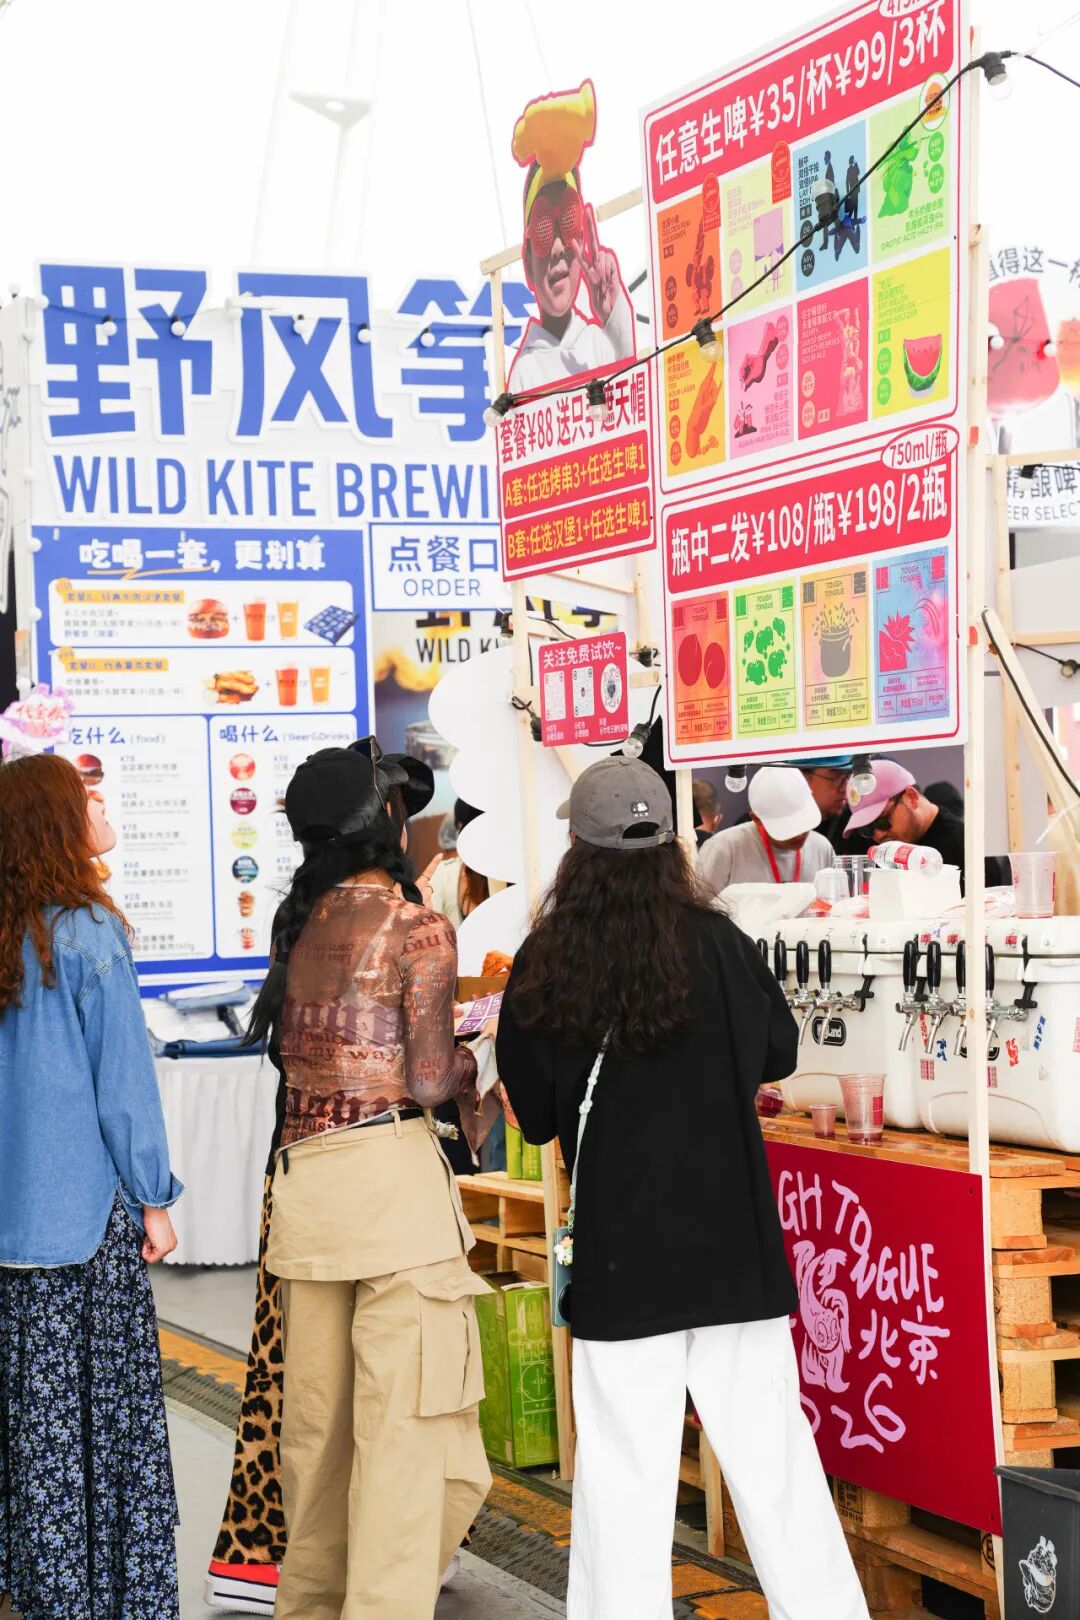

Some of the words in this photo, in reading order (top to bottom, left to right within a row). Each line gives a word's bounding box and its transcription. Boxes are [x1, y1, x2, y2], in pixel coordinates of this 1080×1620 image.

[40, 264, 537, 444] 野风筝
[890, 429, 948, 467] 750ml/瓶
[53, 456, 187, 515] WILD
[208, 459, 317, 517] KITE
[336, 462, 500, 519] BREWI
[672, 464, 949, 576] 瓶中二发¥108/瓶¥198/2瓶
[388, 536, 498, 574] 点餐口
[403, 578, 481, 597] ORDER
[416, 638, 470, 664] WILD
[219, 725, 278, 743] 喝什么
[859, 1305, 950, 1385] 北京
